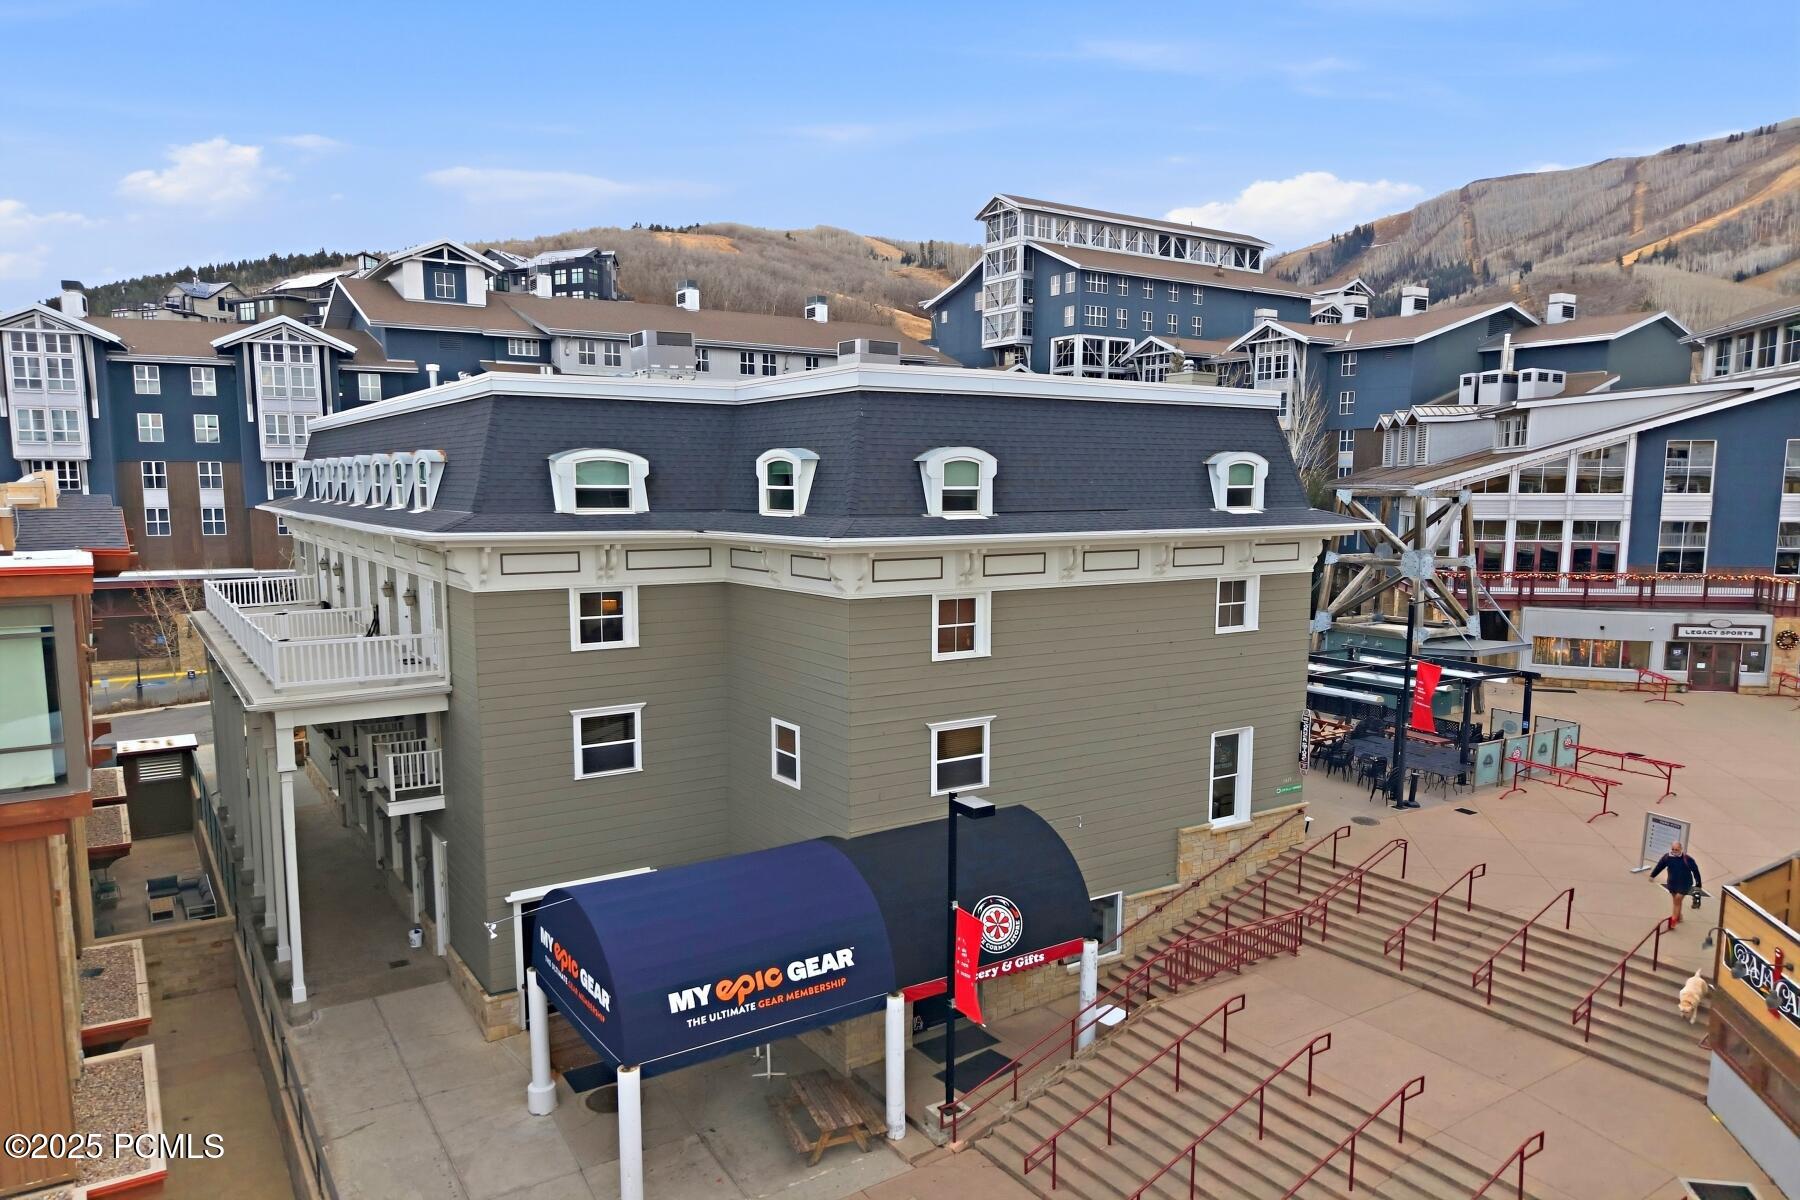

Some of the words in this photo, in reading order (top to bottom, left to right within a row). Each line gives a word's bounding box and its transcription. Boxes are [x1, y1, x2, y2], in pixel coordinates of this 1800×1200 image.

[985, 942, 1012, 951] CORNER
[1010, 920, 1020, 943] STORE
[540, 926, 553, 952] MY
[580, 968, 610, 1012] GEAR
[668, 984, 711, 1014] MY
[787, 948, 854, 982] GEAR
[976, 966, 999, 980] ery
[1002, 961, 1013, 972] &
[1015, 953, 1045, 968] Gifts
[686, 1014, 707, 1028] THE
[709, 1002, 756, 1022] ULTIMATE
[758, 996, 784, 1009] GEAR
[786, 977, 847, 1002] MEMBERSHIP
[1775, 981, 1800, 1018] CA
